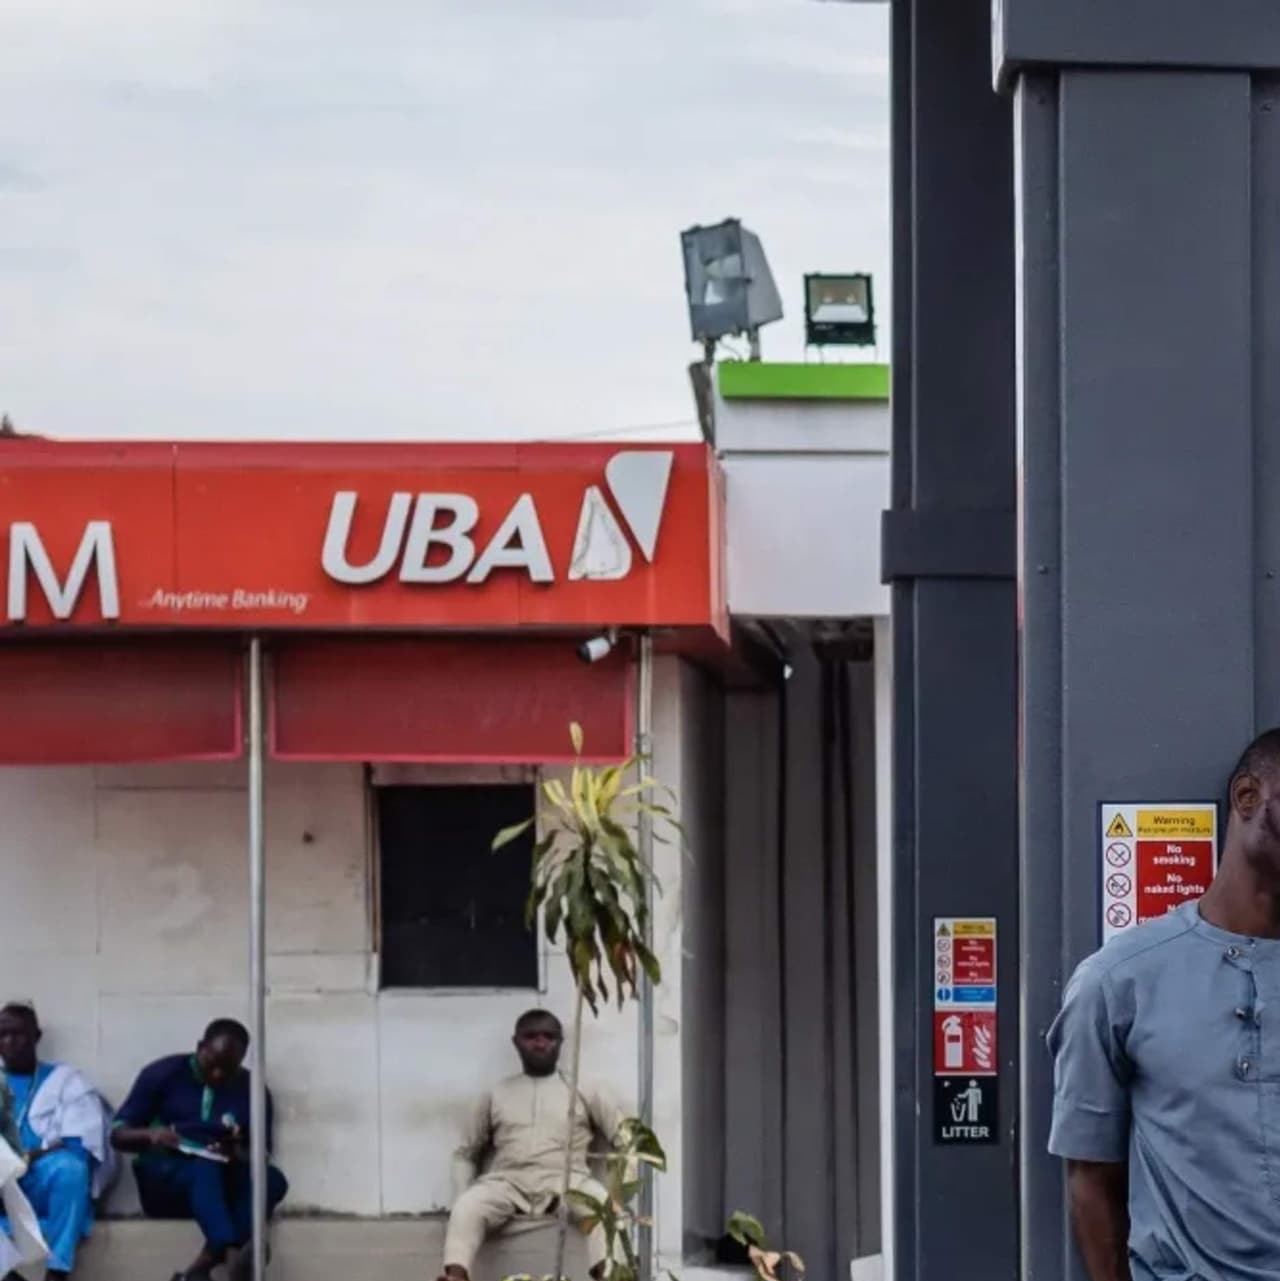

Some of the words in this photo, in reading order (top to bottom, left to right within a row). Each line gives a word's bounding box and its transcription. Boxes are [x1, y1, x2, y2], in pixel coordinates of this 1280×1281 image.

[320, 490, 556, 584] UBA
[232, 588, 309, 614] Banking
[1153, 815, 1196, 826] Warning
[1166, 844, 1182, 854] No
[1152, 855, 1196, 867] smoking
[1166, 873, 1183, 883] No
[1144, 883, 1175, 894] naked
[1176, 883, 1205, 895] lights
[941, 1126, 990, 1138] LITTER
